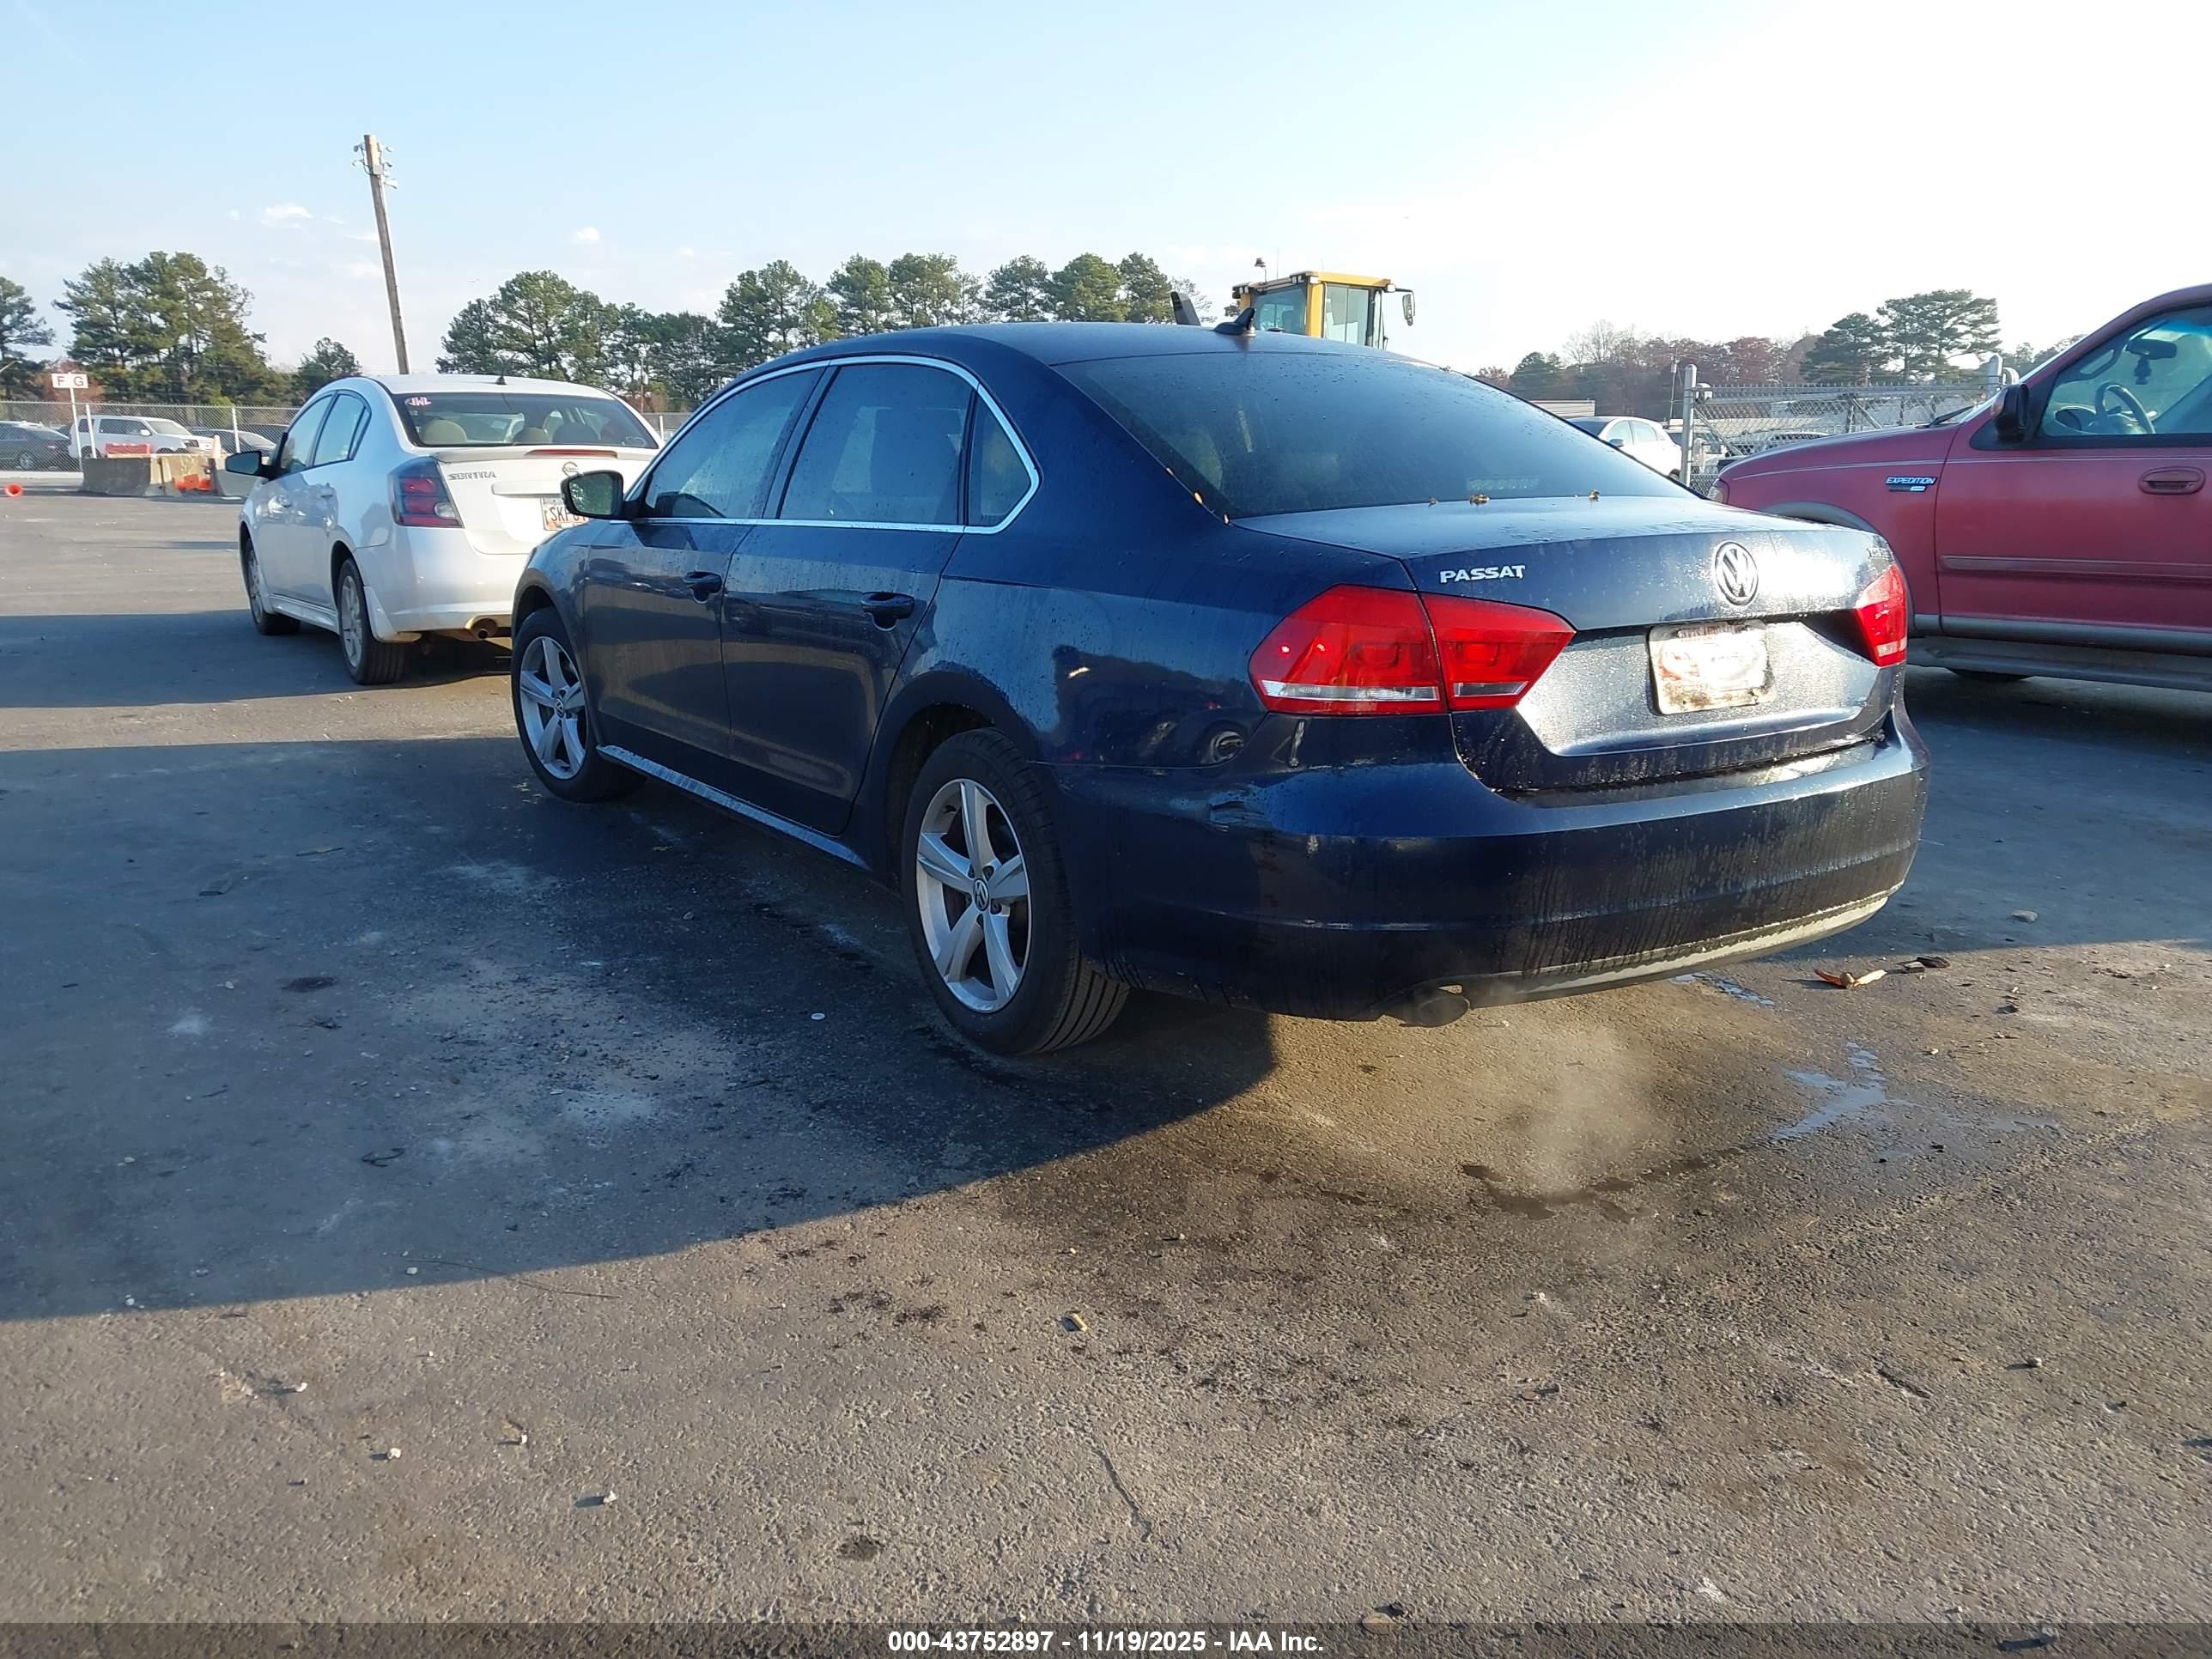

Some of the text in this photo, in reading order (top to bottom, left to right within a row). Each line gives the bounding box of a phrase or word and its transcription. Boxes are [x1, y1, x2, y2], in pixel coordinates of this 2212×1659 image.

[57, 376, 84, 386] F G
[447, 471, 497, 481] SENTRA
[1886, 477, 1936, 485] EXPEDITION
[1440, 565, 1525, 584] PASSAT
